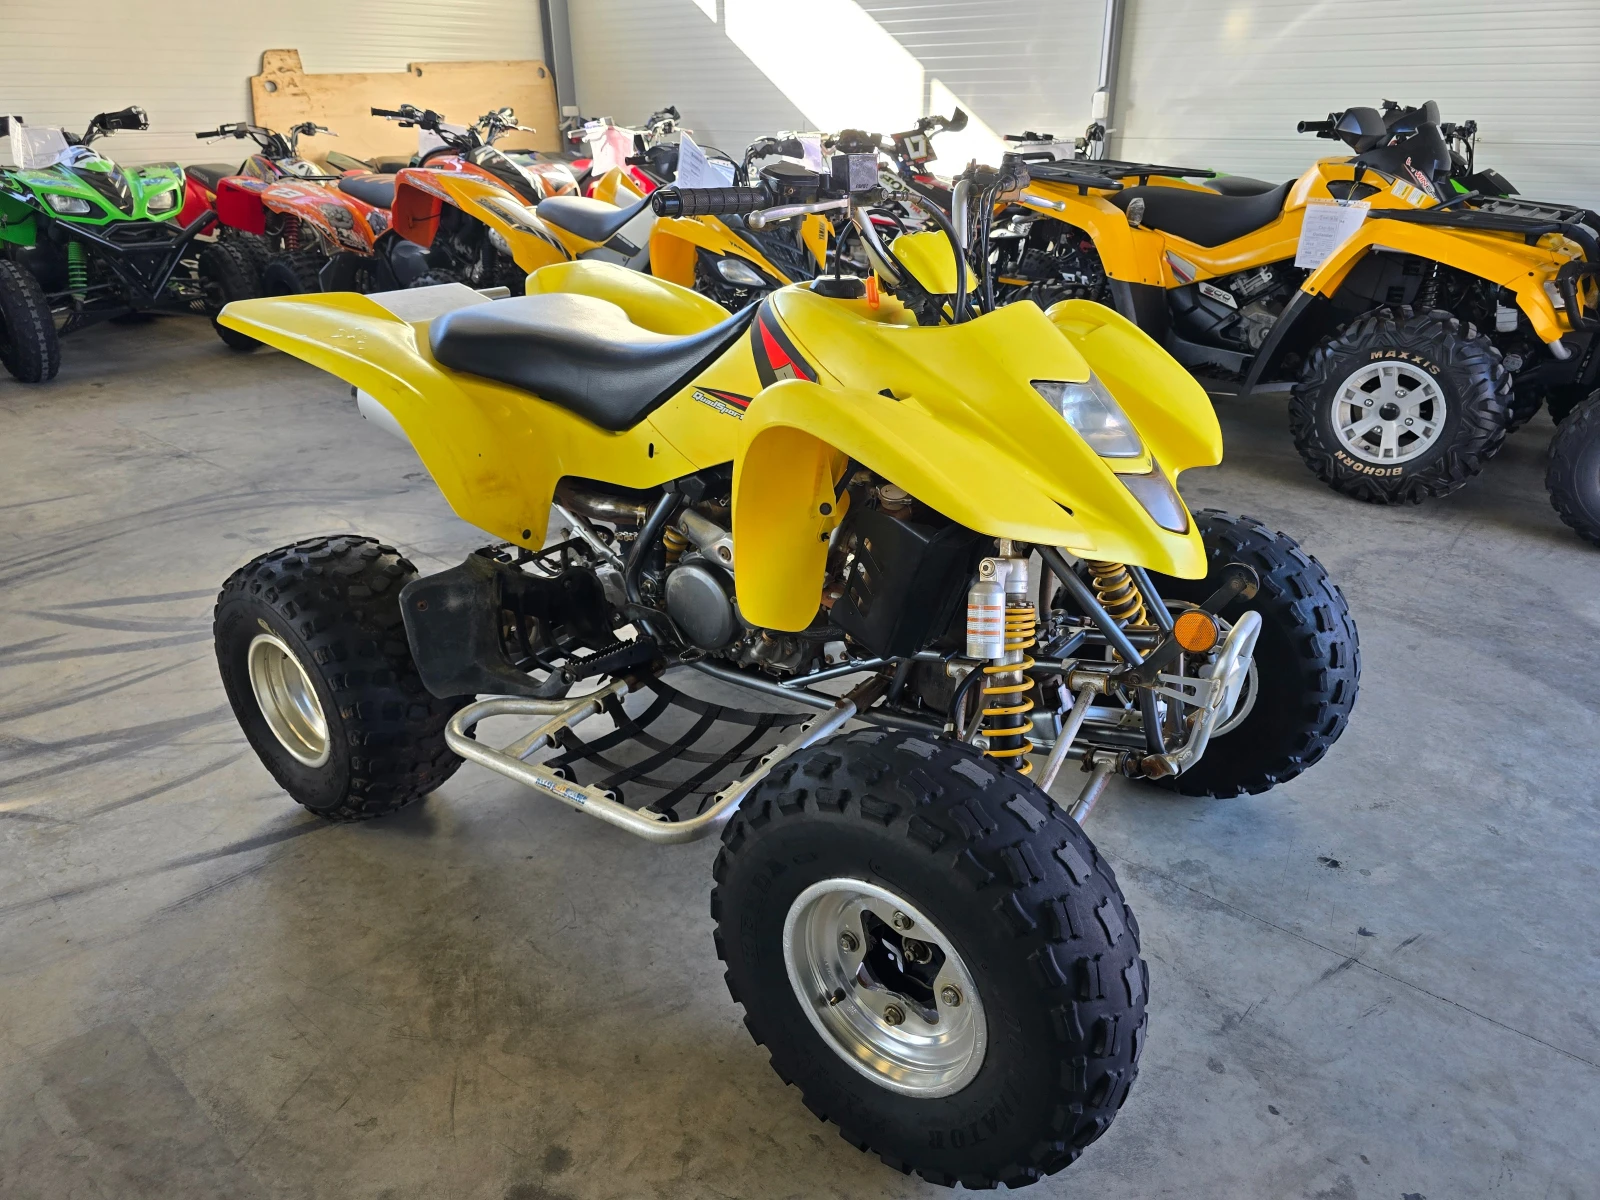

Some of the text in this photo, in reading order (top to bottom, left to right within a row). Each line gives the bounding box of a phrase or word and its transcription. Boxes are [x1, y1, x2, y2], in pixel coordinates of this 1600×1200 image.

[189, 168, 209, 184] HONDA
[1370, 350, 1441, 375] MAXXIS
[1334, 450, 1403, 477] BIGHORN
